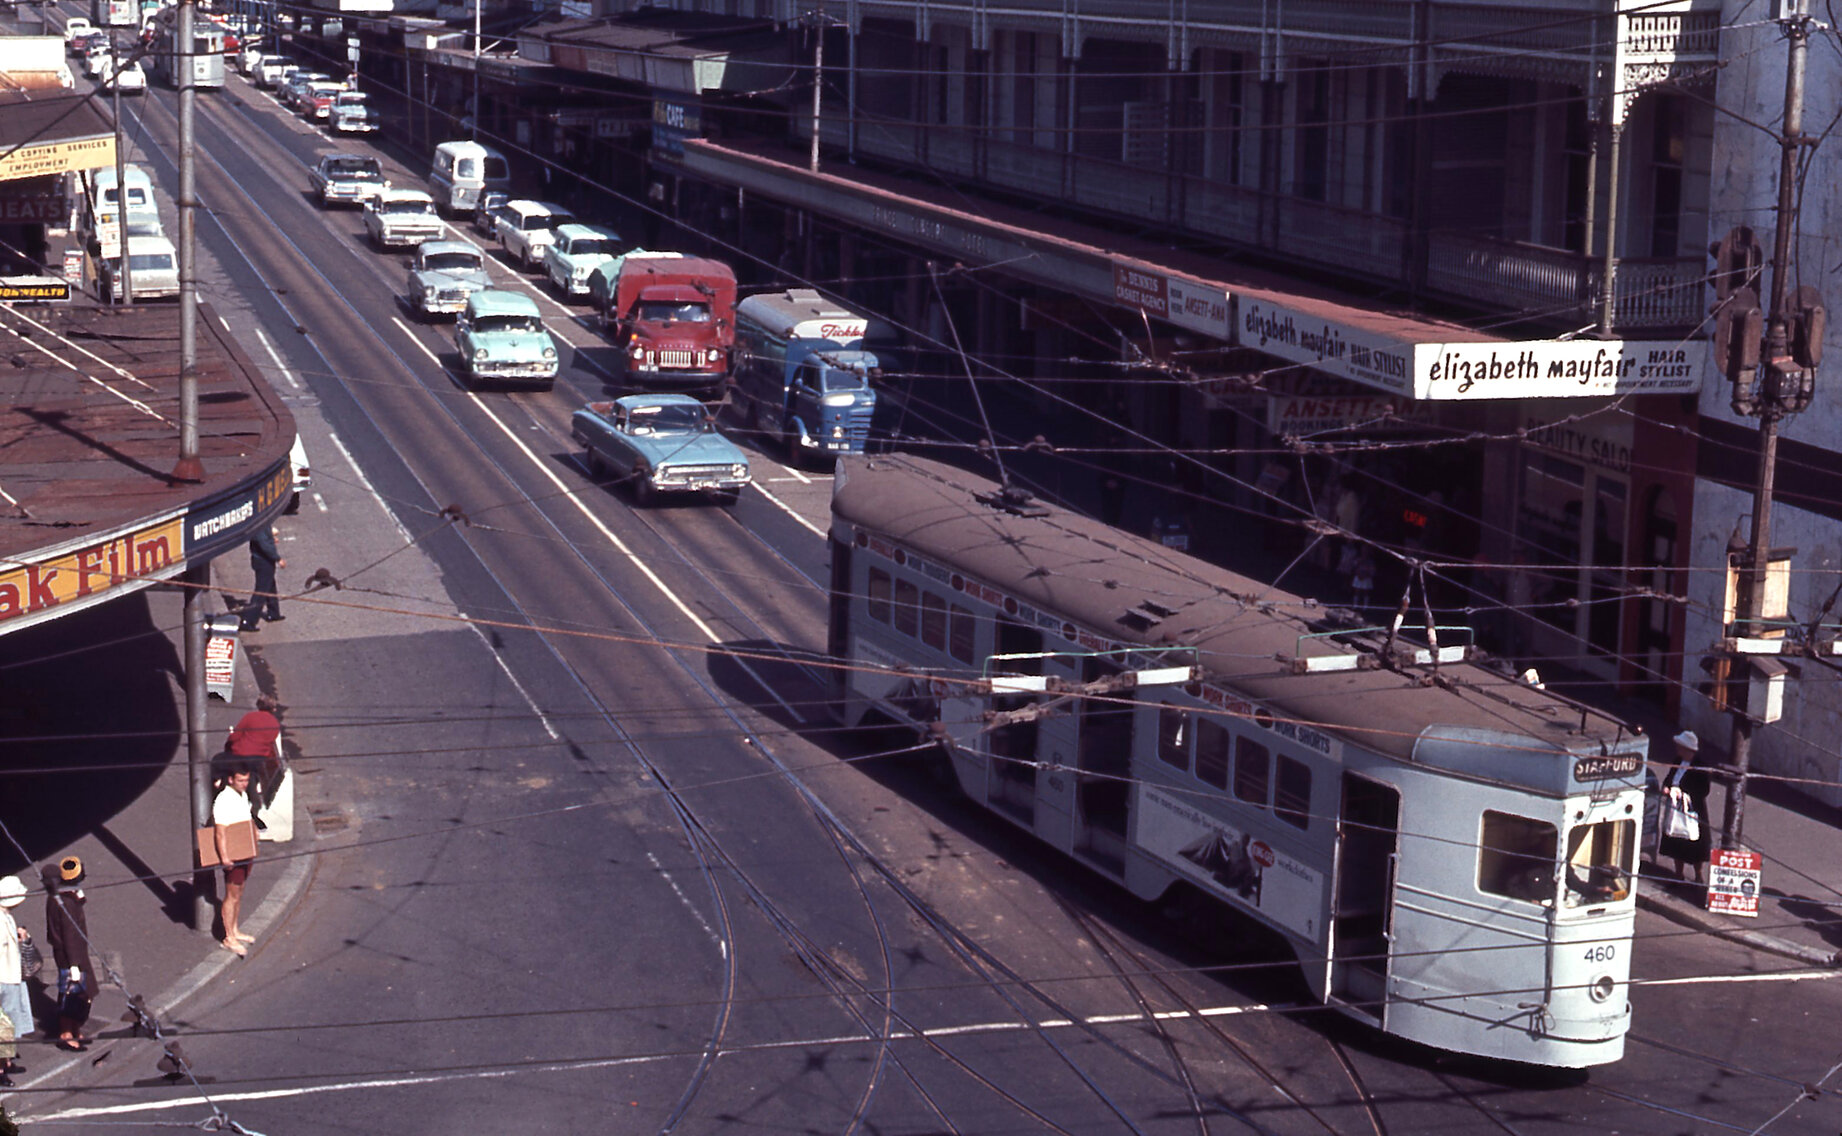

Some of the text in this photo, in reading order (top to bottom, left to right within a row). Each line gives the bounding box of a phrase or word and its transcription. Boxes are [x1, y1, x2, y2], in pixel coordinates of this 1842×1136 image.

[667, 104, 684, 128] CAFE
[20, 146, 58, 157] COPYING
[67, 140, 108, 152] SERVICES
[9, 158, 69, 172] EMPLOYMENT
[0, 201, 58, 218] EATS
[1246, 305, 1297, 347] elizabeth
[1301, 324, 1346, 361] mayfair
[1351, 343, 1371, 369] HAIR
[1373, 350, 1406, 379] STYLIST
[1648, 350, 1686, 363] HAIR
[1430, 351, 1539, 393] elizabeth
[1547, 348, 1636, 385] mayfair
[1639, 365, 1692, 377] STYLIST
[1527, 418, 1587, 459] BEAUTY
[76, 533, 173, 598] Film
[1203, 684, 1224, 708] WORK
[1225, 693, 1252, 719] SHORTS
[1298, 726, 1330, 754] SHORTS
[1720, 855, 1754, 869] POST
[1713, 867, 1758, 879] CONFESSIONS
[1584, 945, 1616, 963] 460
